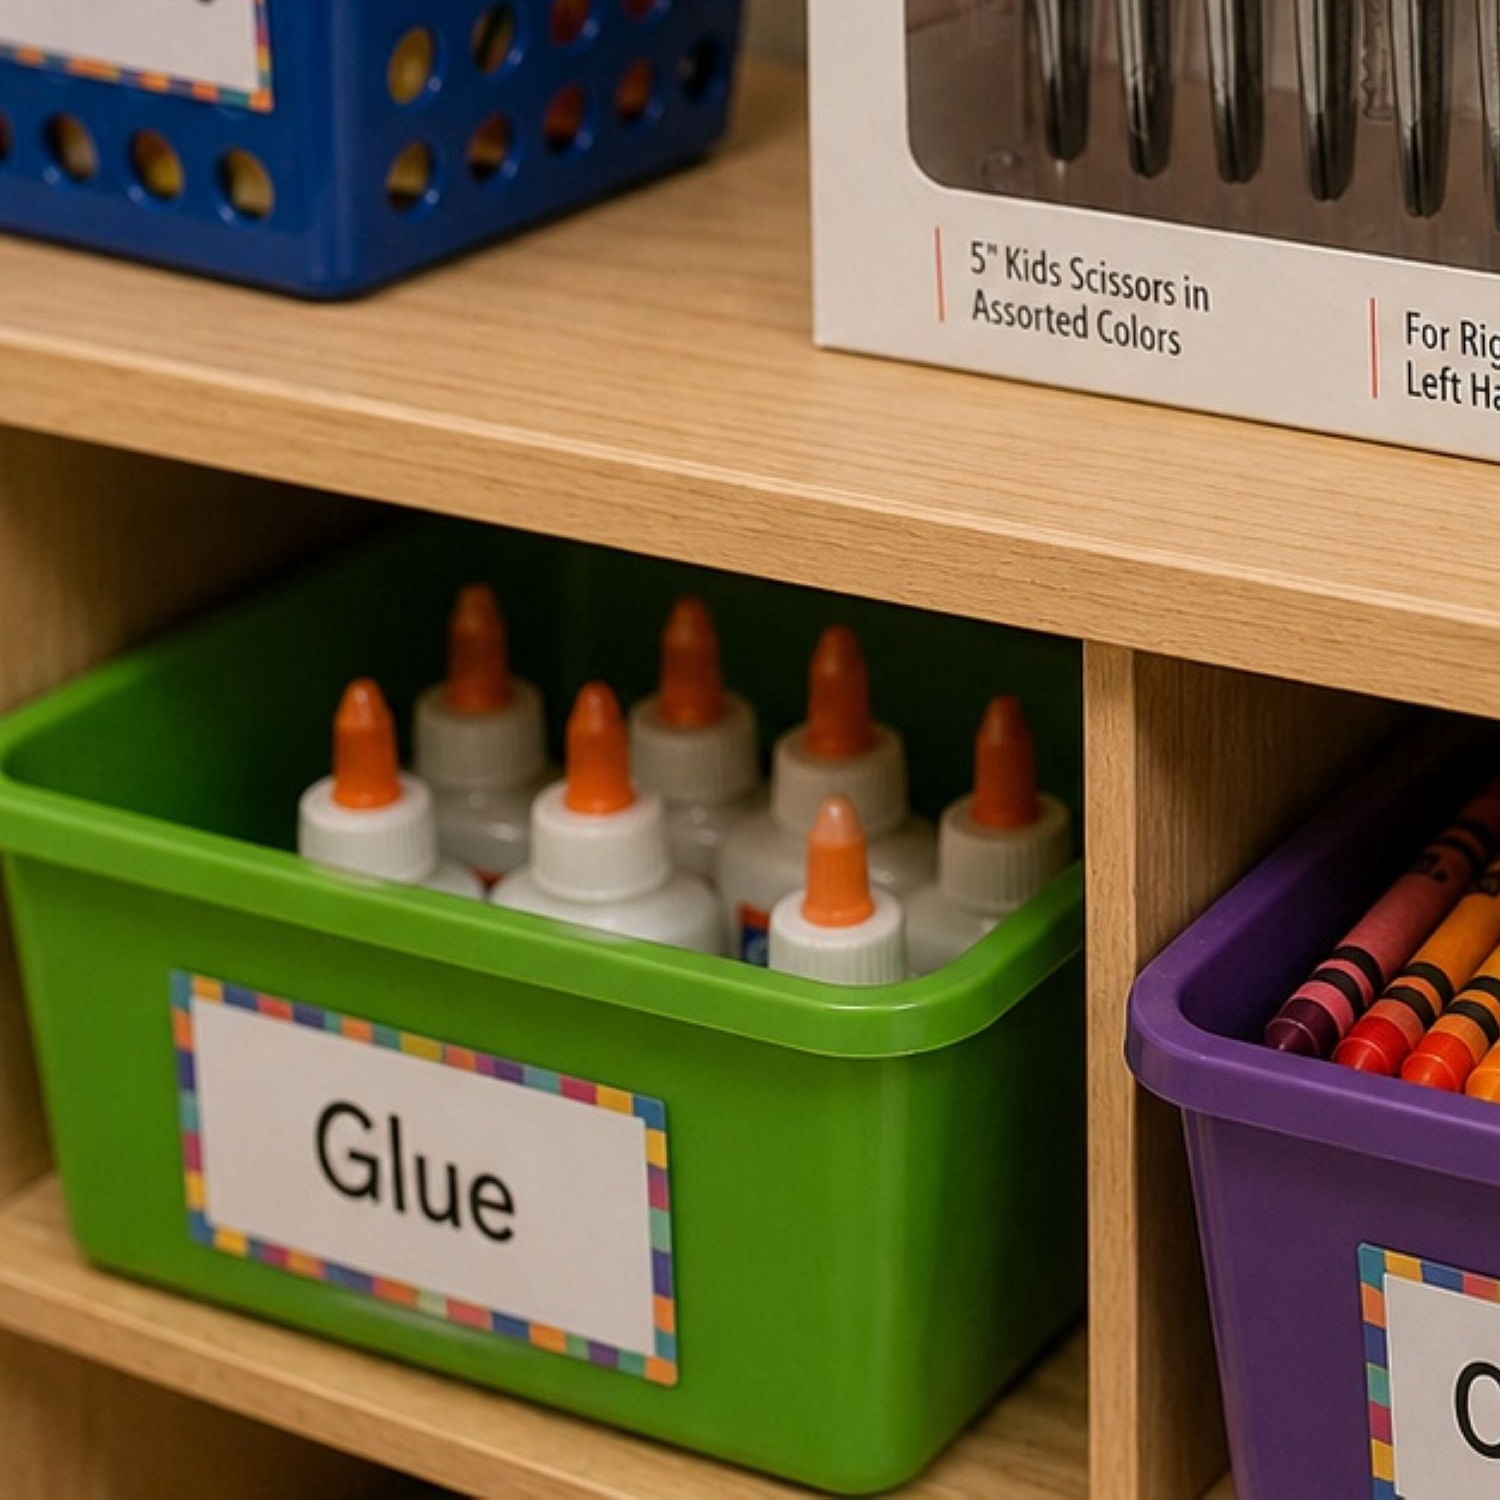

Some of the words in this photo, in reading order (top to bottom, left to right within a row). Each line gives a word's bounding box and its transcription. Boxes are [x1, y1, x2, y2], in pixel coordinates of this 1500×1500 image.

[1005, 244, 1062, 287] Kids
[1070, 256, 1176, 306] Scissors
[1184, 275, 1210, 312] in
[972, 288, 1089, 340] Assorted
[1097, 309, 1182, 357] Colors
[1406, 310, 1450, 351] For
[1407, 360, 1462, 404] Left
[315, 1101, 515, 1243] Glue
